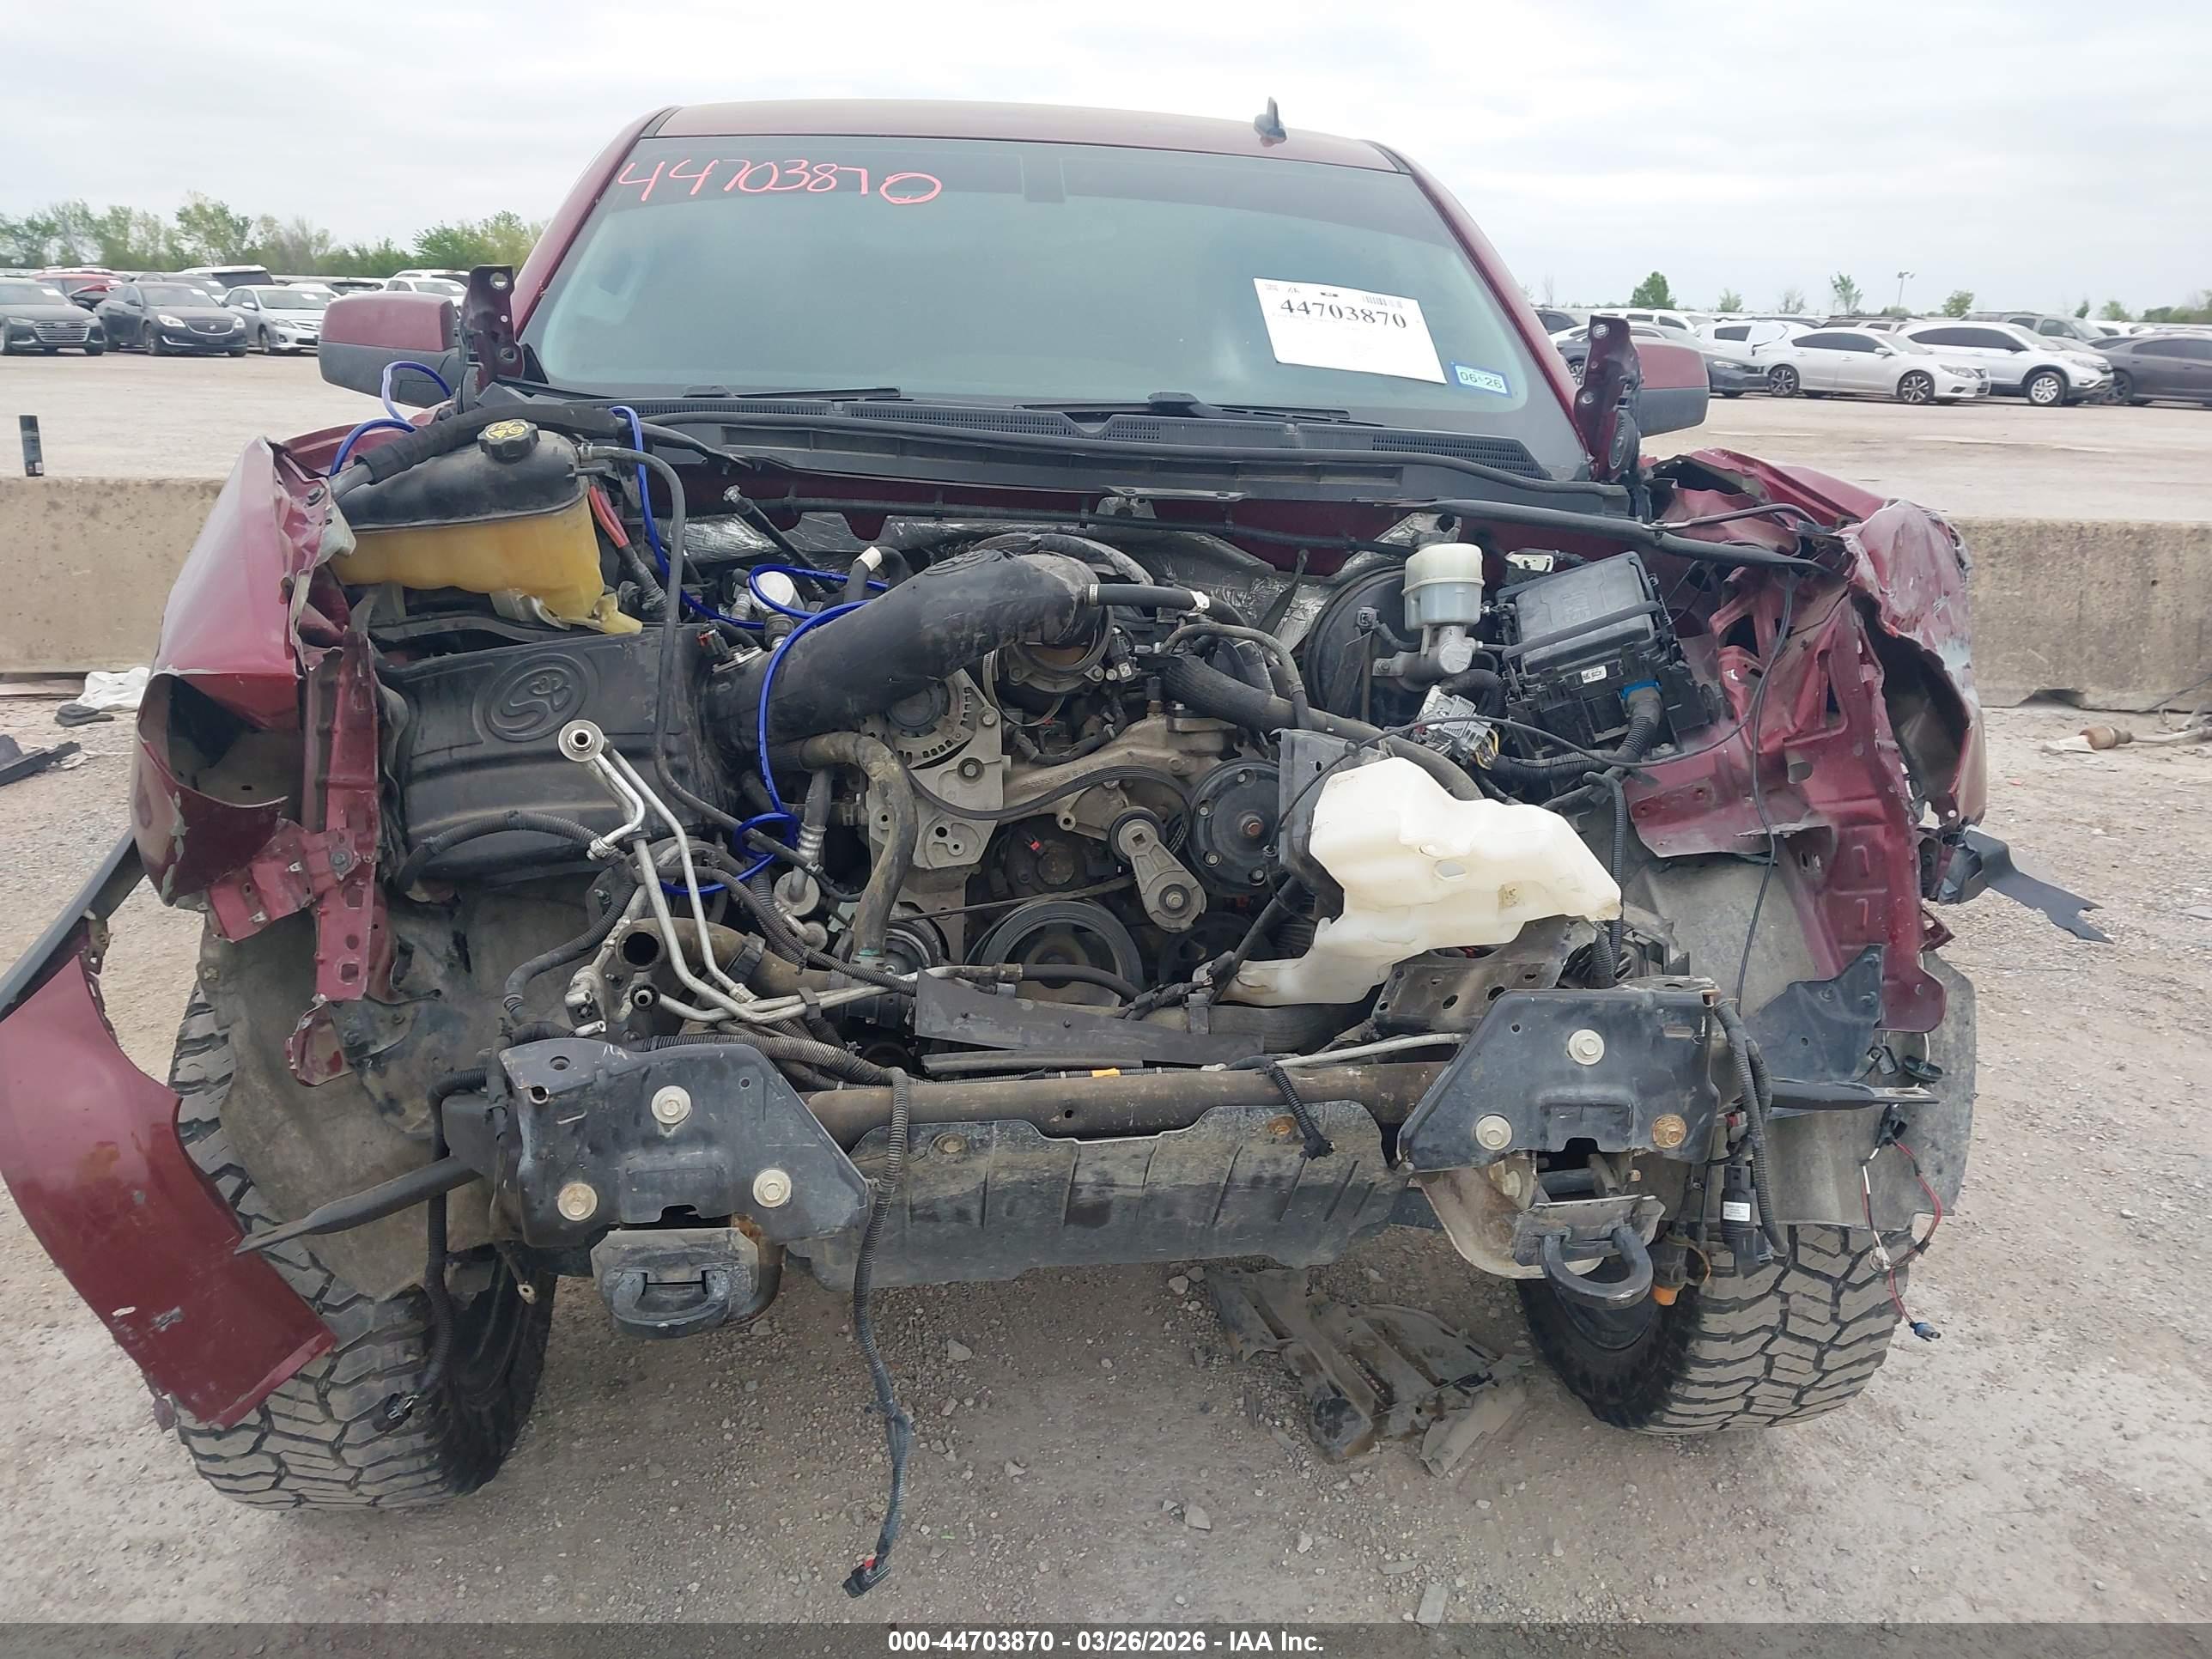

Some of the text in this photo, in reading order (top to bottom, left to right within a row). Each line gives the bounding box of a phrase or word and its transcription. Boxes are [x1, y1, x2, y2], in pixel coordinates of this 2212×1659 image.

[617, 158, 943, 204] 44703870
[1279, 298, 1407, 329] 44703870
[1460, 371, 1503, 389] 06 26
